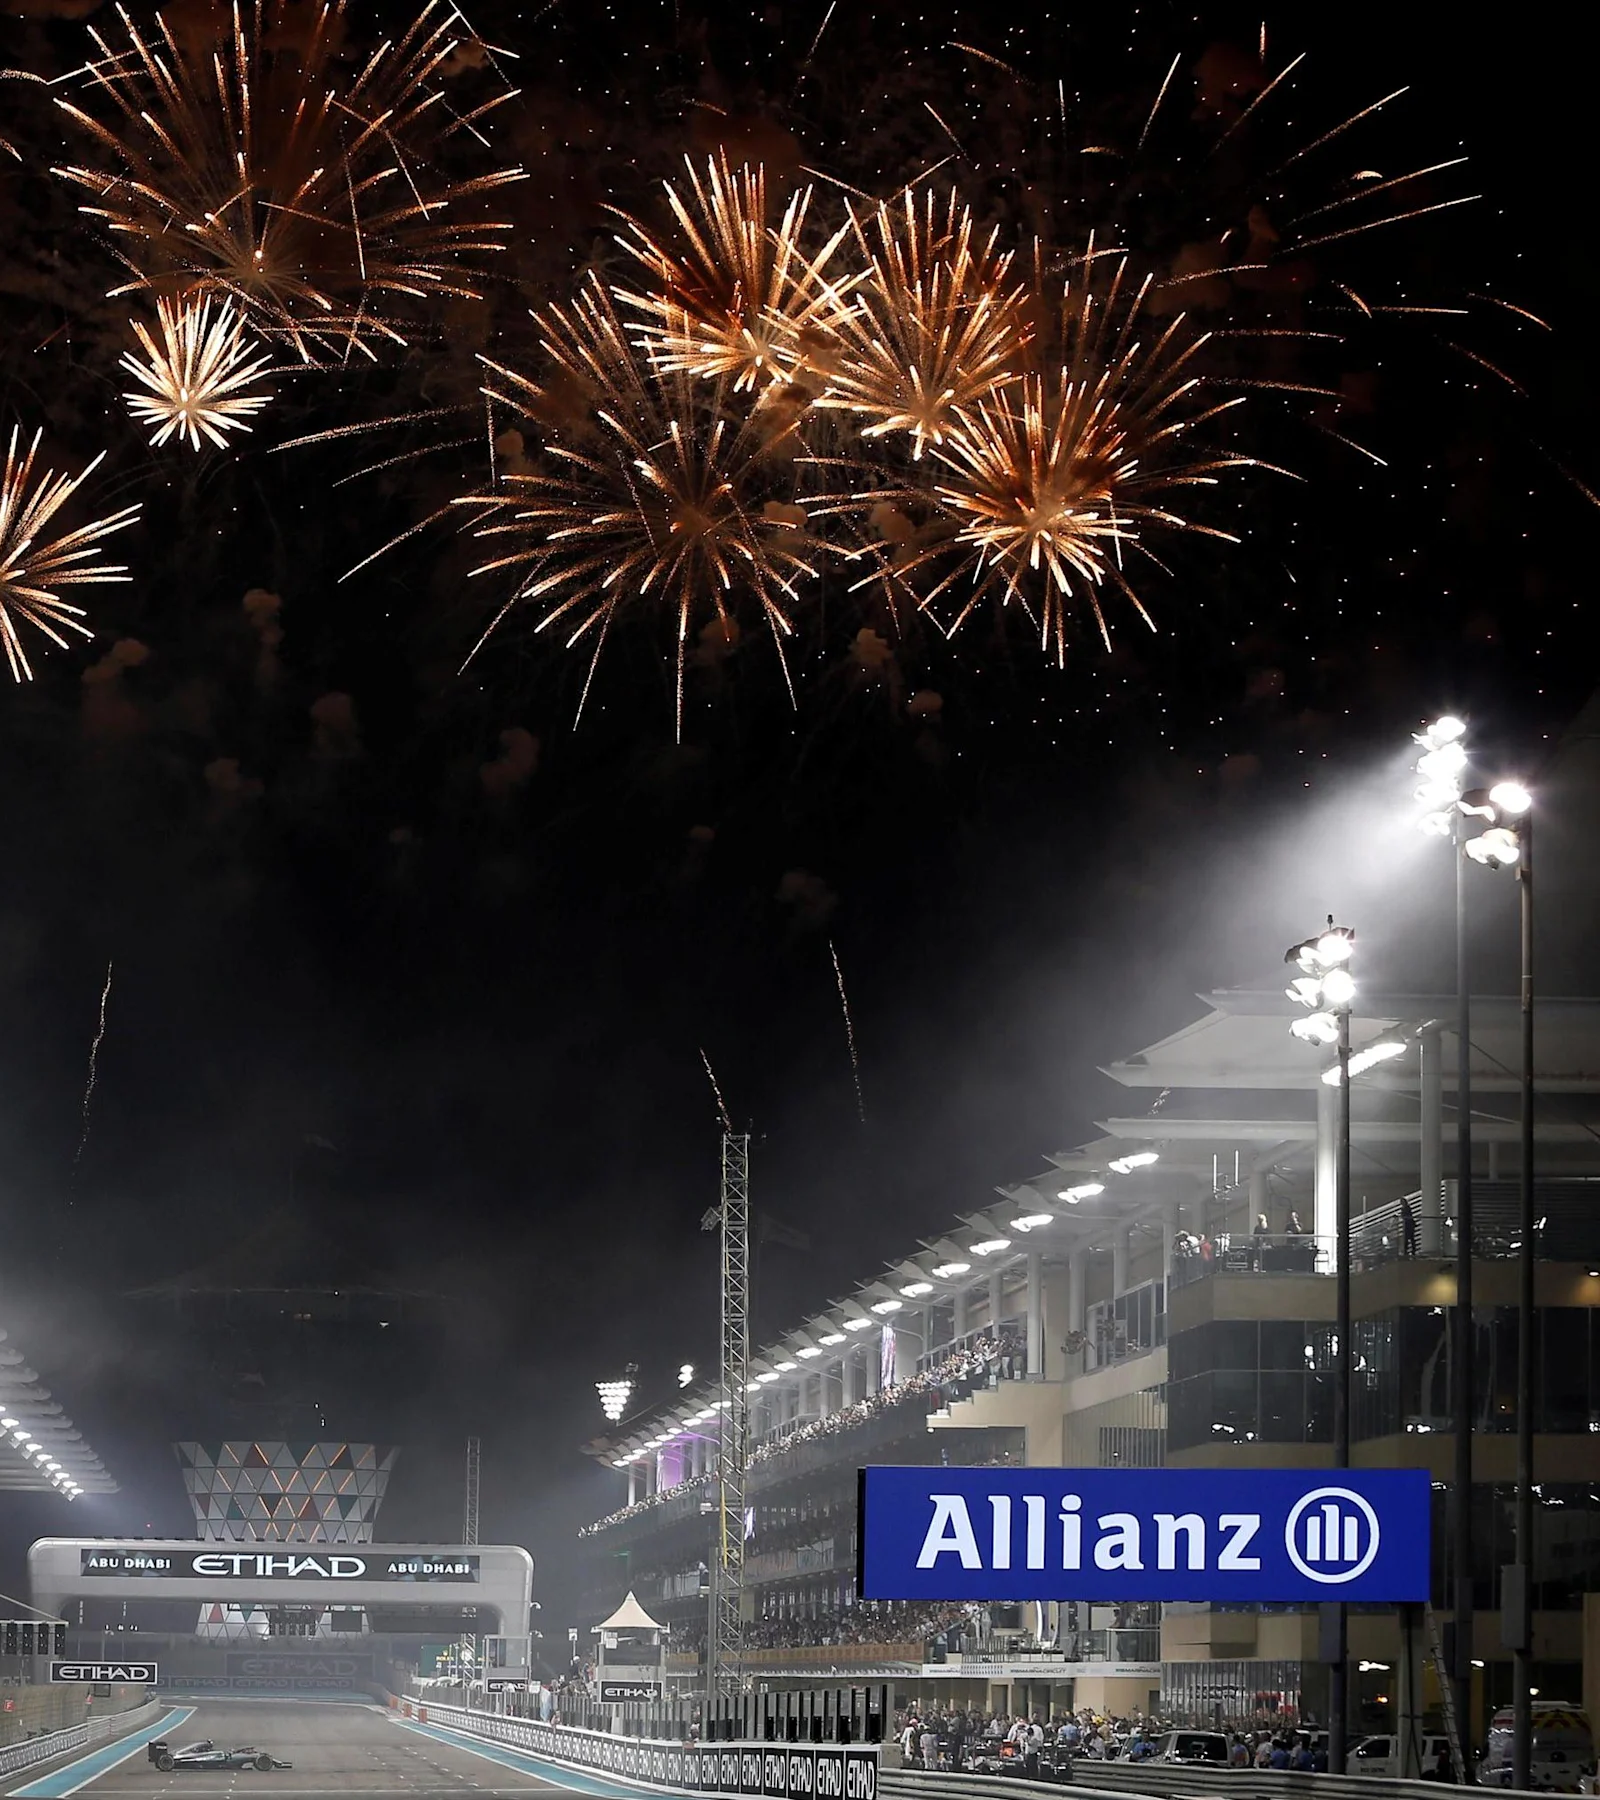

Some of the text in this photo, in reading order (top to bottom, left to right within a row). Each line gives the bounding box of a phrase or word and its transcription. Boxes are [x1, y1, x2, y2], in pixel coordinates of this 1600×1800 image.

[915, 1493, 1261, 1571] Allianz
[89, 1557, 171, 1569] ABU DHABI
[192, 1553, 366, 1578] ETIHAD
[388, 1563, 470, 1574] ABU DHABI
[58, 1665, 149, 1680] ETIHAD
[241, 1659, 358, 1676] ETIHAD
[174, 1678, 228, 1687] ETIHAD
[236, 1679, 288, 1688] ETIHAD
[741, 1754, 761, 1786] ETIHAD
[764, 1754, 786, 1789] ETIHAD
[789, 1756, 813, 1793] ETIHAD
[816, 1758, 842, 1796] ETIHAD
[846, 1759, 875, 1799] ETIHAD
